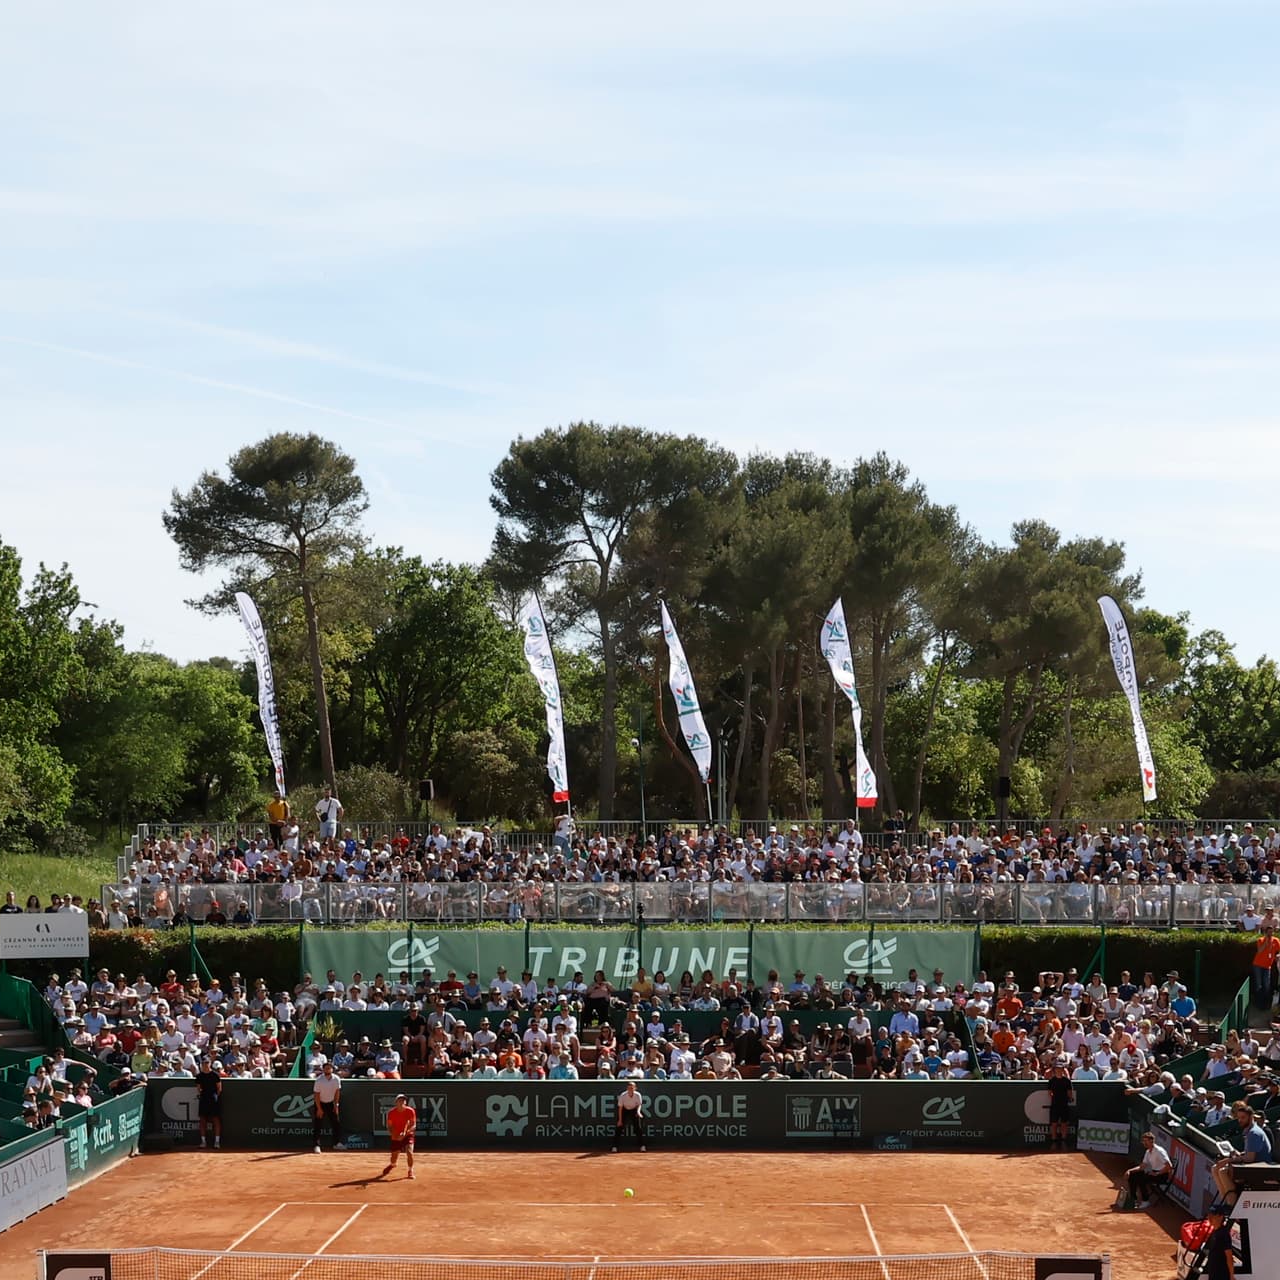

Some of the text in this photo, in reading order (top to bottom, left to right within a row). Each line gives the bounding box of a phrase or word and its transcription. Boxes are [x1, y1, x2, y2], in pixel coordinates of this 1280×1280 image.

[527, 945, 750, 978] TRIBUNE
[252, 1125, 286, 1135] CRÉDIT
[936, 1130, 984, 1138] AGRICOLE
[1023, 1134, 1046, 1142] TOUR
[1, 1149, 56, 1197] RAYNAL
